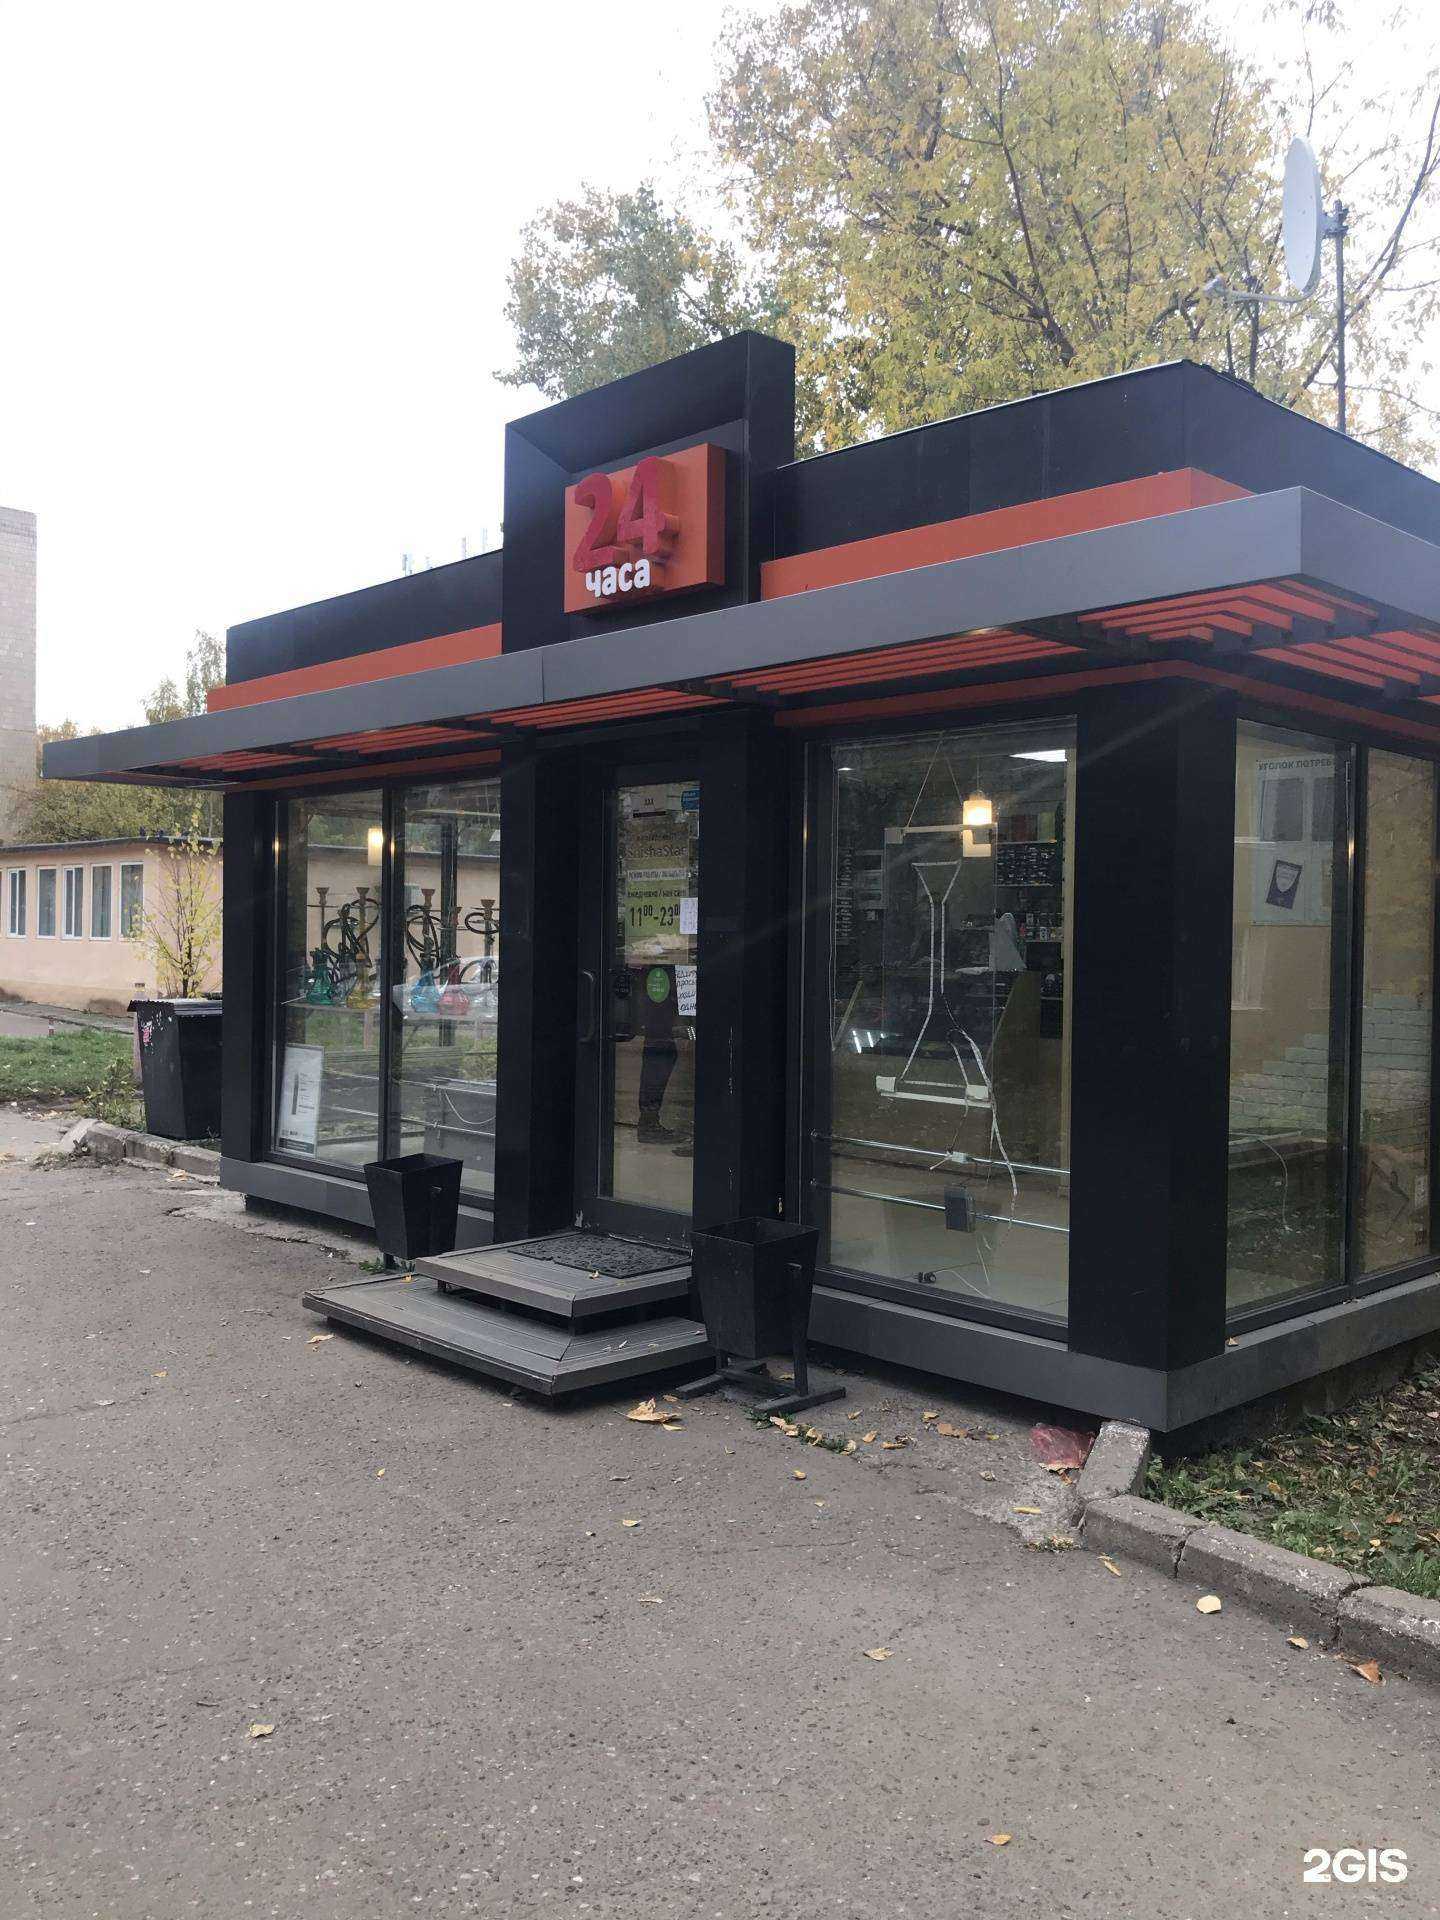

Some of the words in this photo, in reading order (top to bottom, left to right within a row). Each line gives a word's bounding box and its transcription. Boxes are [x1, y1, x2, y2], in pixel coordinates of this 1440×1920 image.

[573, 456, 669, 573] 24
[585, 558, 650, 598] часа
[1258, 759, 1295, 770] УГОЛОК
